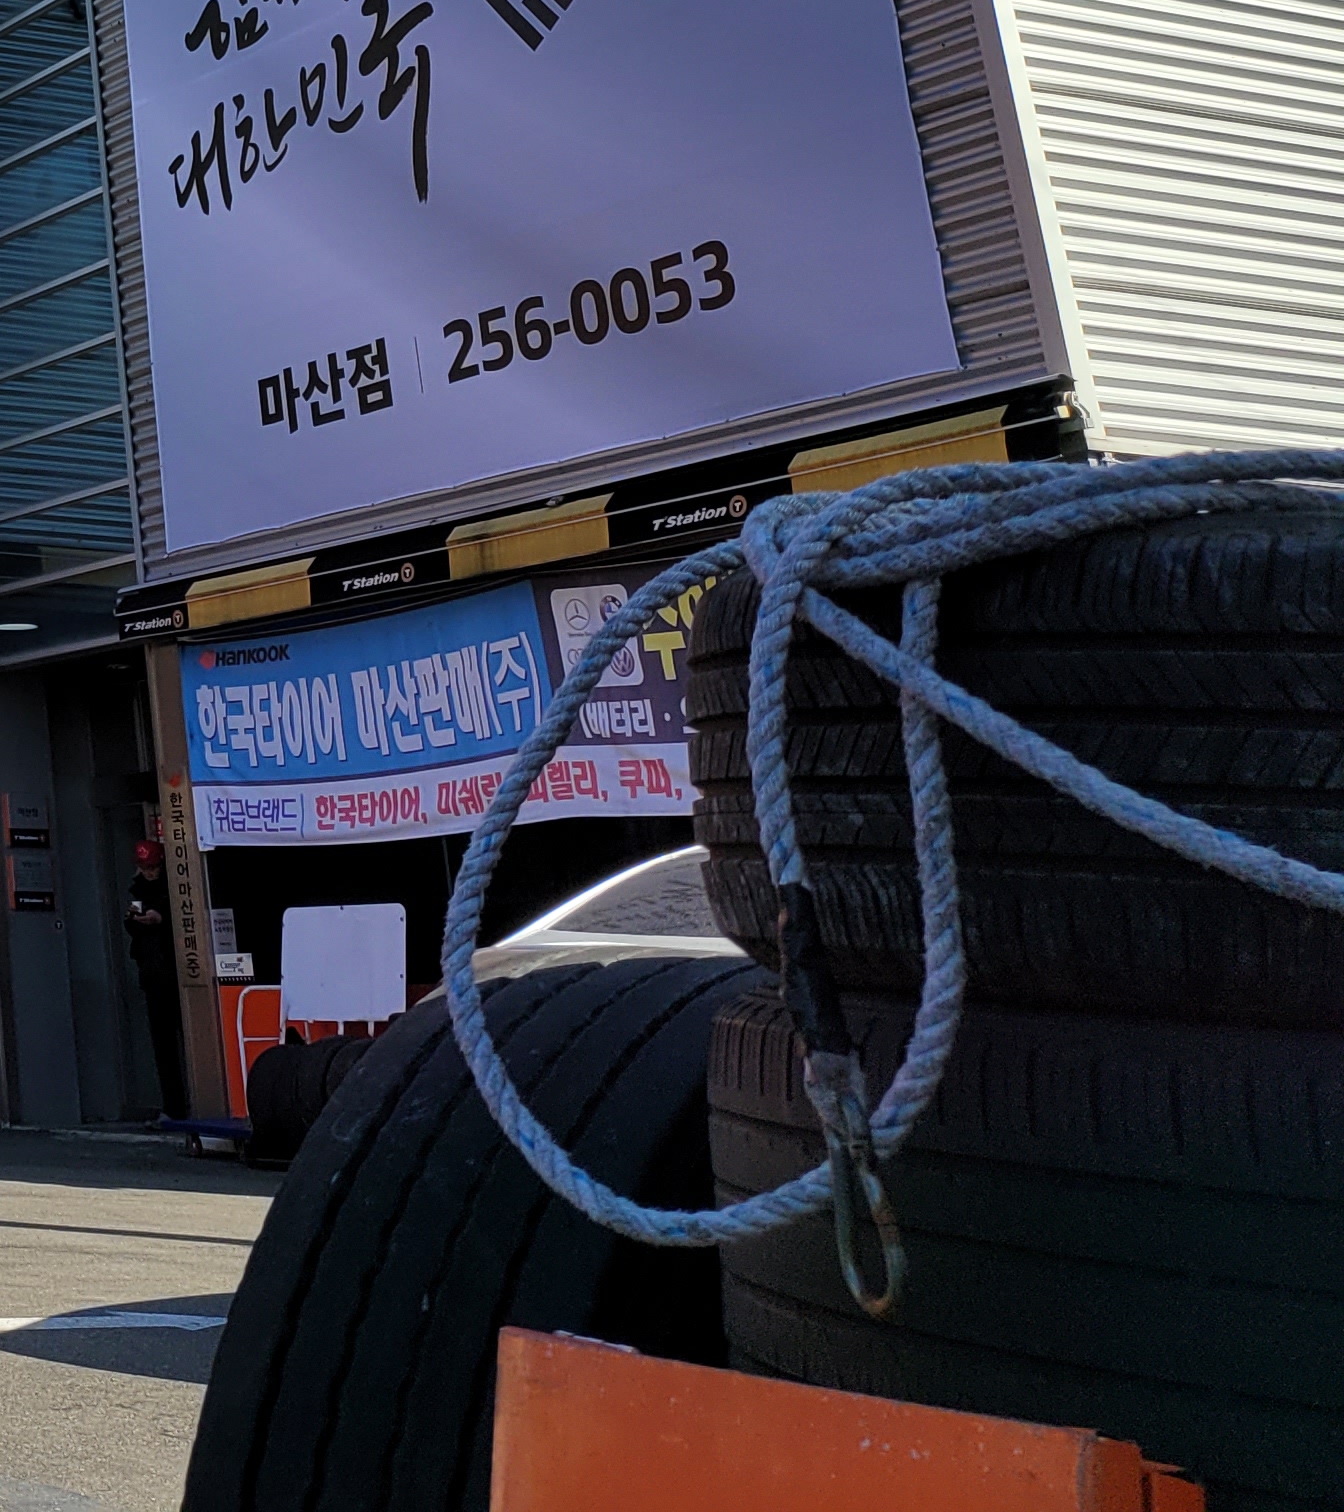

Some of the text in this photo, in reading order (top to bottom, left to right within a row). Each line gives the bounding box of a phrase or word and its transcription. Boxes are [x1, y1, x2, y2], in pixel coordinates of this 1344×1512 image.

[257, 240, 736, 435] 마산점 256-0053
[652, 506, 727, 531] T'Station
[342, 571, 399, 591] T'Station
[124, 617, 172, 632] T'Station
[196, 631, 542, 768] 한국타이어 마산판매(주)
[212, 796, 298, 833] 취급브랜드
[315, 787, 428, 831] 한국타이어,
